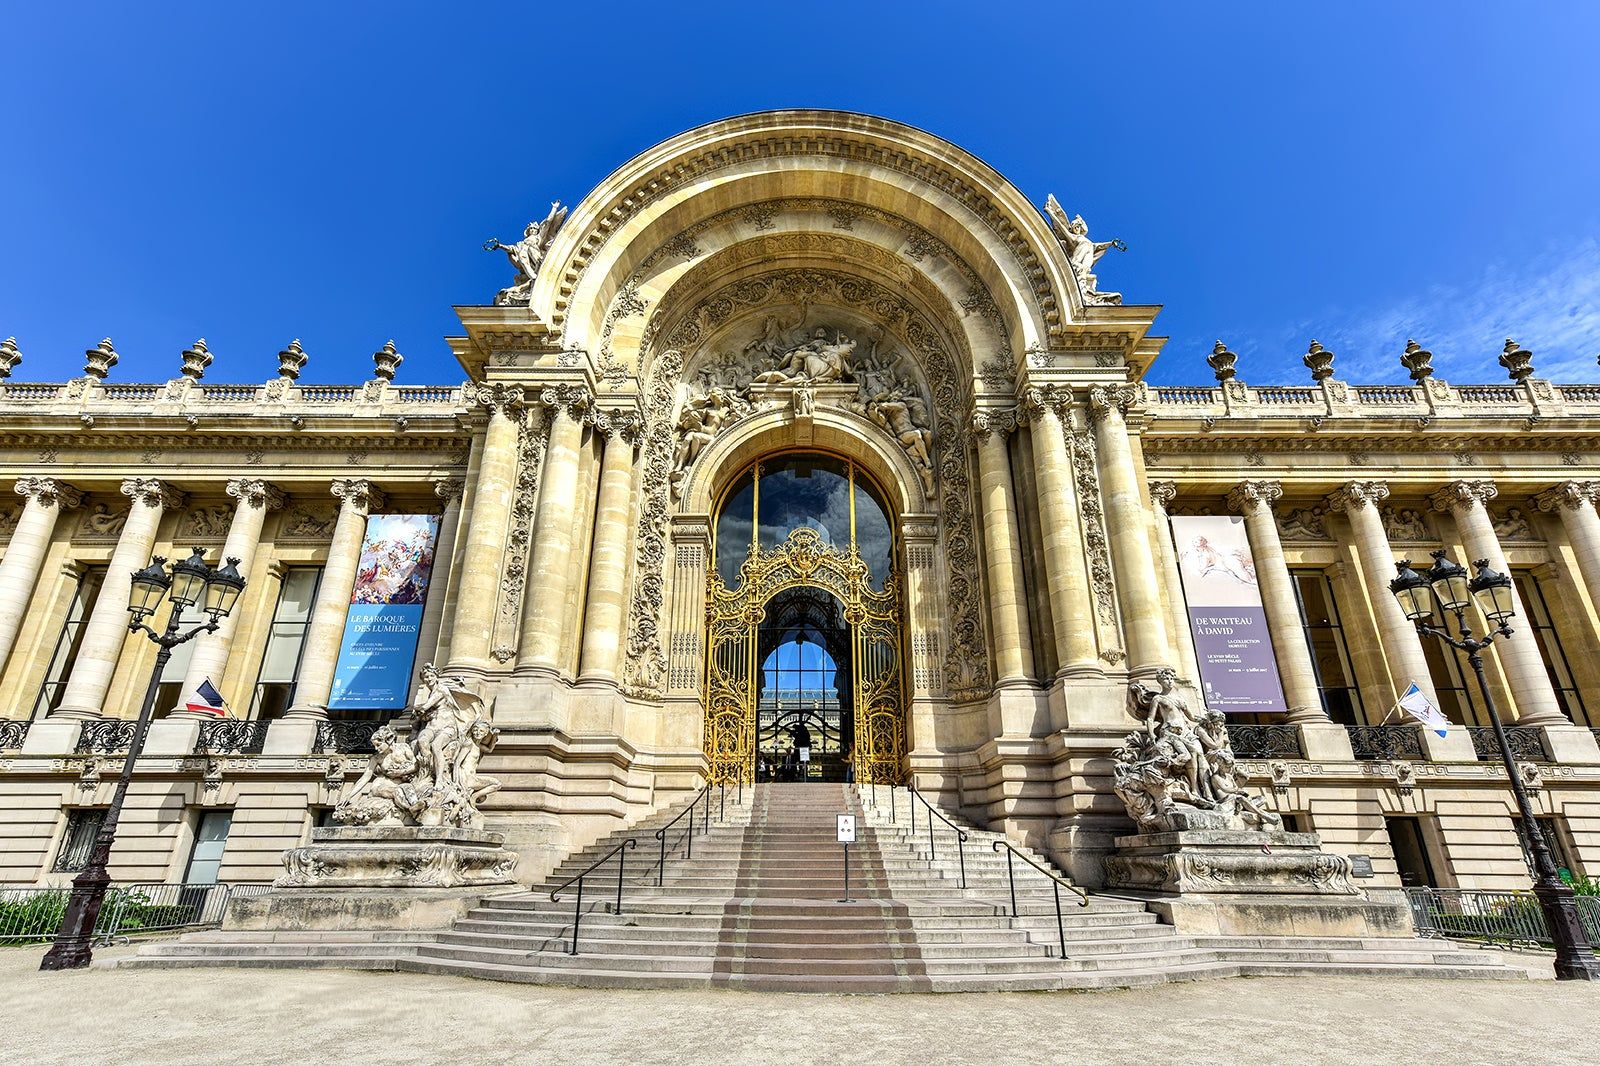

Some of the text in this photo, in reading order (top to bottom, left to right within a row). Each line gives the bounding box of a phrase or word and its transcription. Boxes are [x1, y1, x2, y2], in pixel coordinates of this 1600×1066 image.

[363, 615, 405, 624] BAROQUE
[1196, 617, 1253, 625] DE WATTEAU
[372, 623, 416, 632] LUMIÈRES
[1198, 625, 1234, 635] À DAVID
